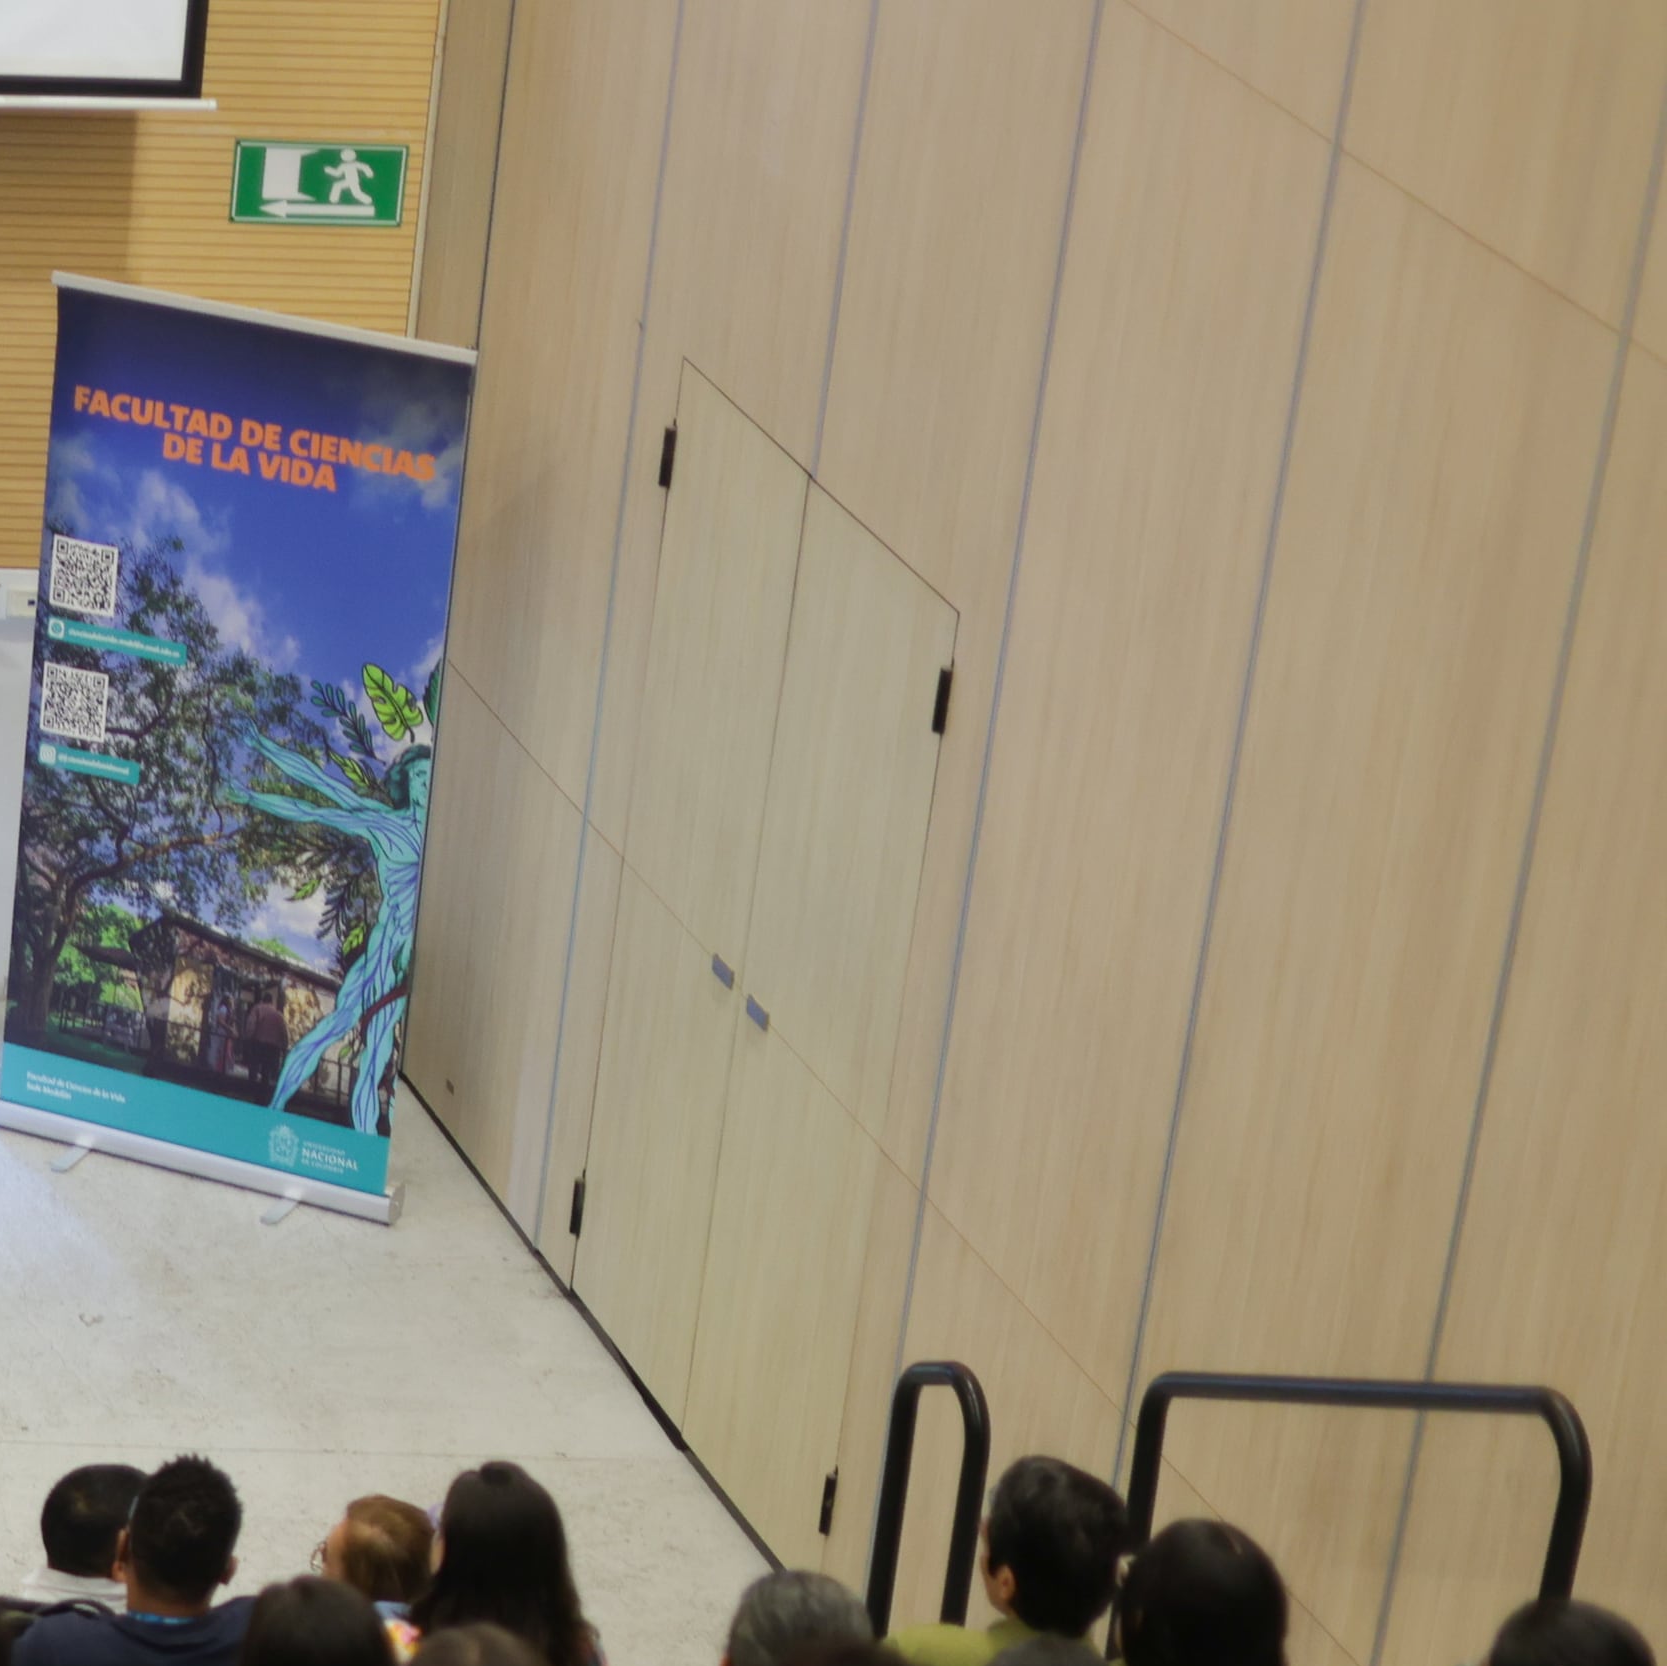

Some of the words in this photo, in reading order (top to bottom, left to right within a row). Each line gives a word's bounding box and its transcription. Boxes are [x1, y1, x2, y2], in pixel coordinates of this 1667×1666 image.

[74, 385, 233, 440] FACULTAD
[240, 419, 282, 451] DE
[289, 430, 437, 482] CIENCIAS
[163, 433, 203, 465] DE
[211, 443, 250, 476] LA
[257, 452, 337, 493] VIDA
[302, 1147, 359, 1173] NACIONAL
